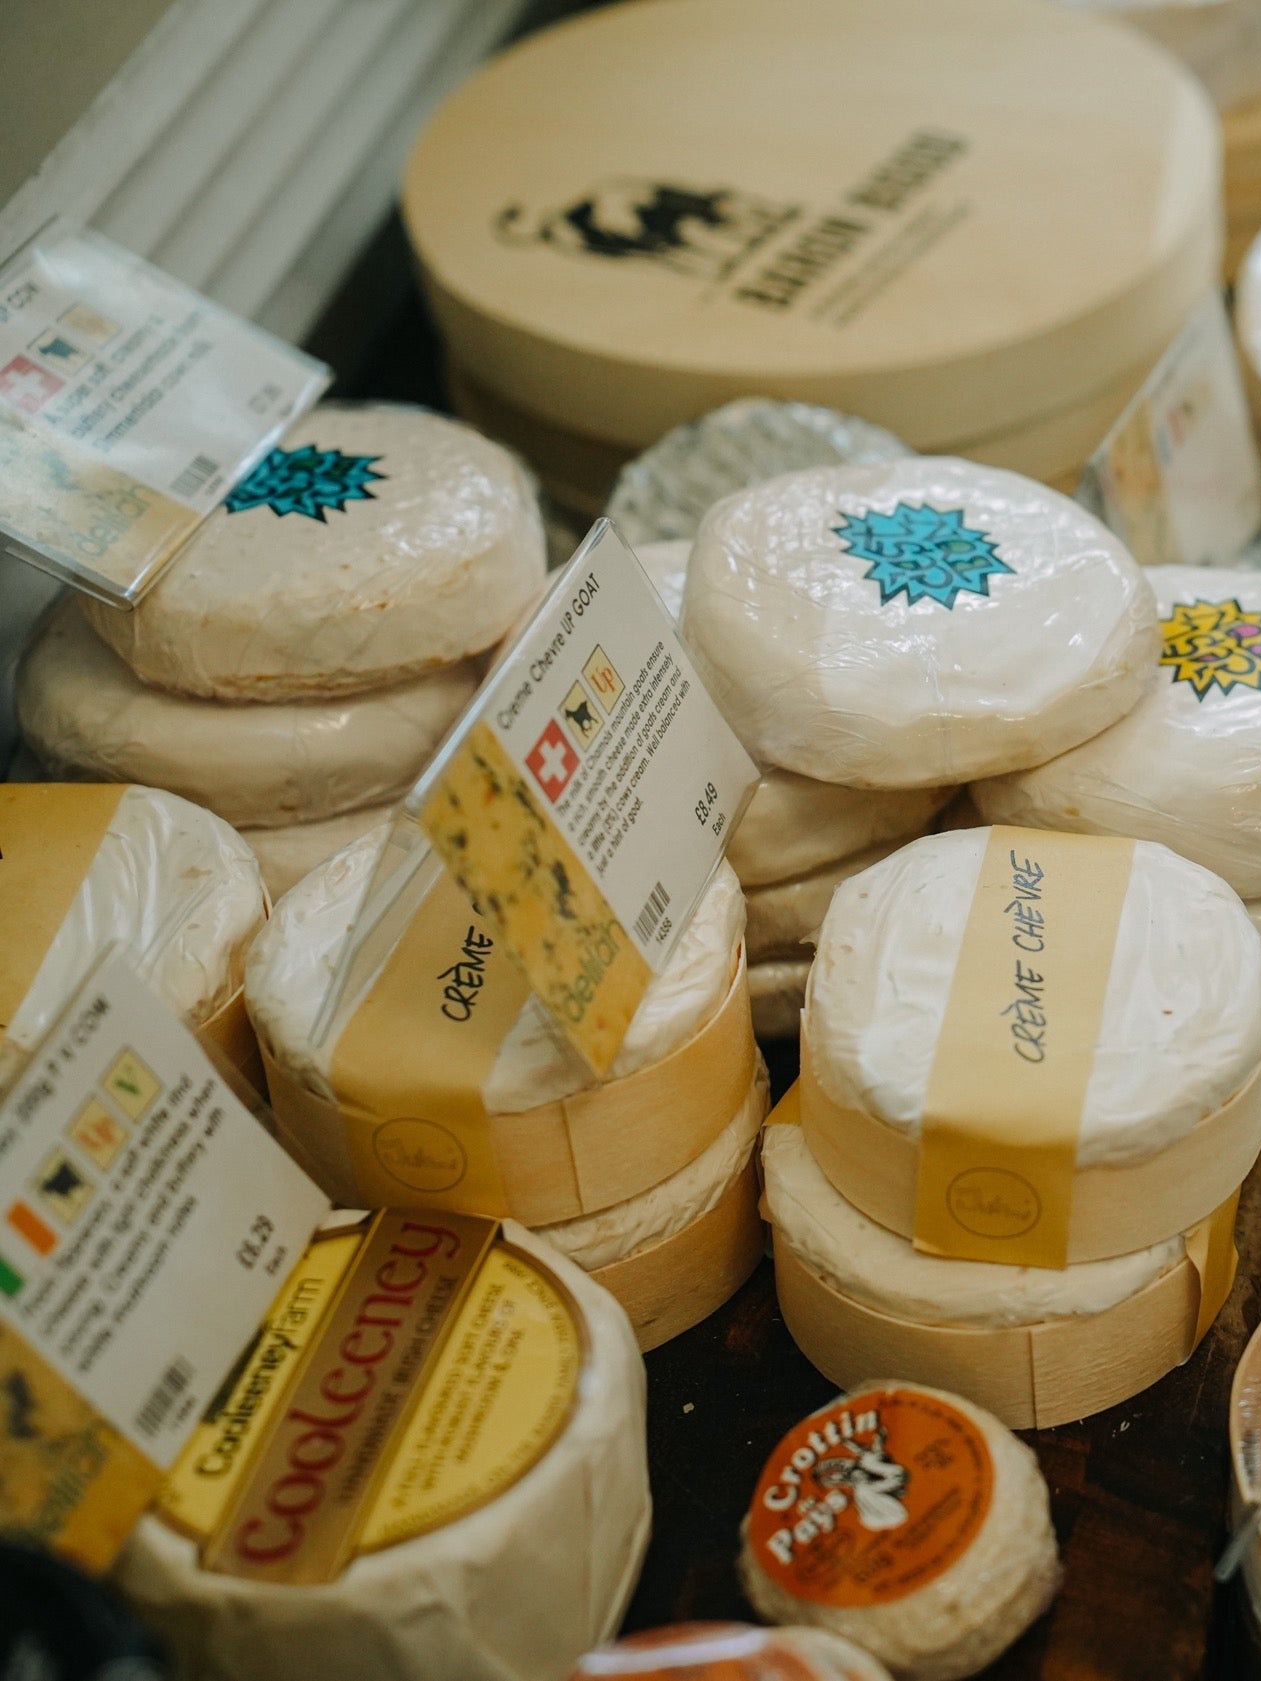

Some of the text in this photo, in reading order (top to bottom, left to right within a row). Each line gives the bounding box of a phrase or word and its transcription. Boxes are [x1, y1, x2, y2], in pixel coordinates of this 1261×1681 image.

[497, 572, 599, 729] Creme Chevre UP GOAT
[590, 667, 615, 693] Up
[610, 691, 635, 731] mountain
[632, 667, 648, 695] goats
[646, 641, 664, 670] ensure
[605, 736, 626, 770] cheese
[624, 710, 640, 738] made
[638, 688, 653, 712] extra
[649, 653, 673, 691] intensely
[615, 745, 638, 782] addition
[636, 731, 644, 747] of
[641, 711, 657, 740] goats
[654, 684, 672, 713] cream
[669, 664, 681, 686] and
[616, 786, 632, 811] cows
[630, 757, 649, 787] cream.
[645, 733, 660, 756] Well
[655, 694, 681, 739] balanced
[678, 680, 690, 699] with
[621, 816, 629, 832] of
[627, 796, 643, 824] goat.
[694, 782, 717, 825] £8.49
[711, 812, 725, 836] Each
[437, 925, 493, 1021] CRÈME
[1001, 850, 1046, 1063] CRÈME CHÈVRE
[763, 1409, 879, 1511] Crottin
[766, 1490, 848, 1565] Pays
